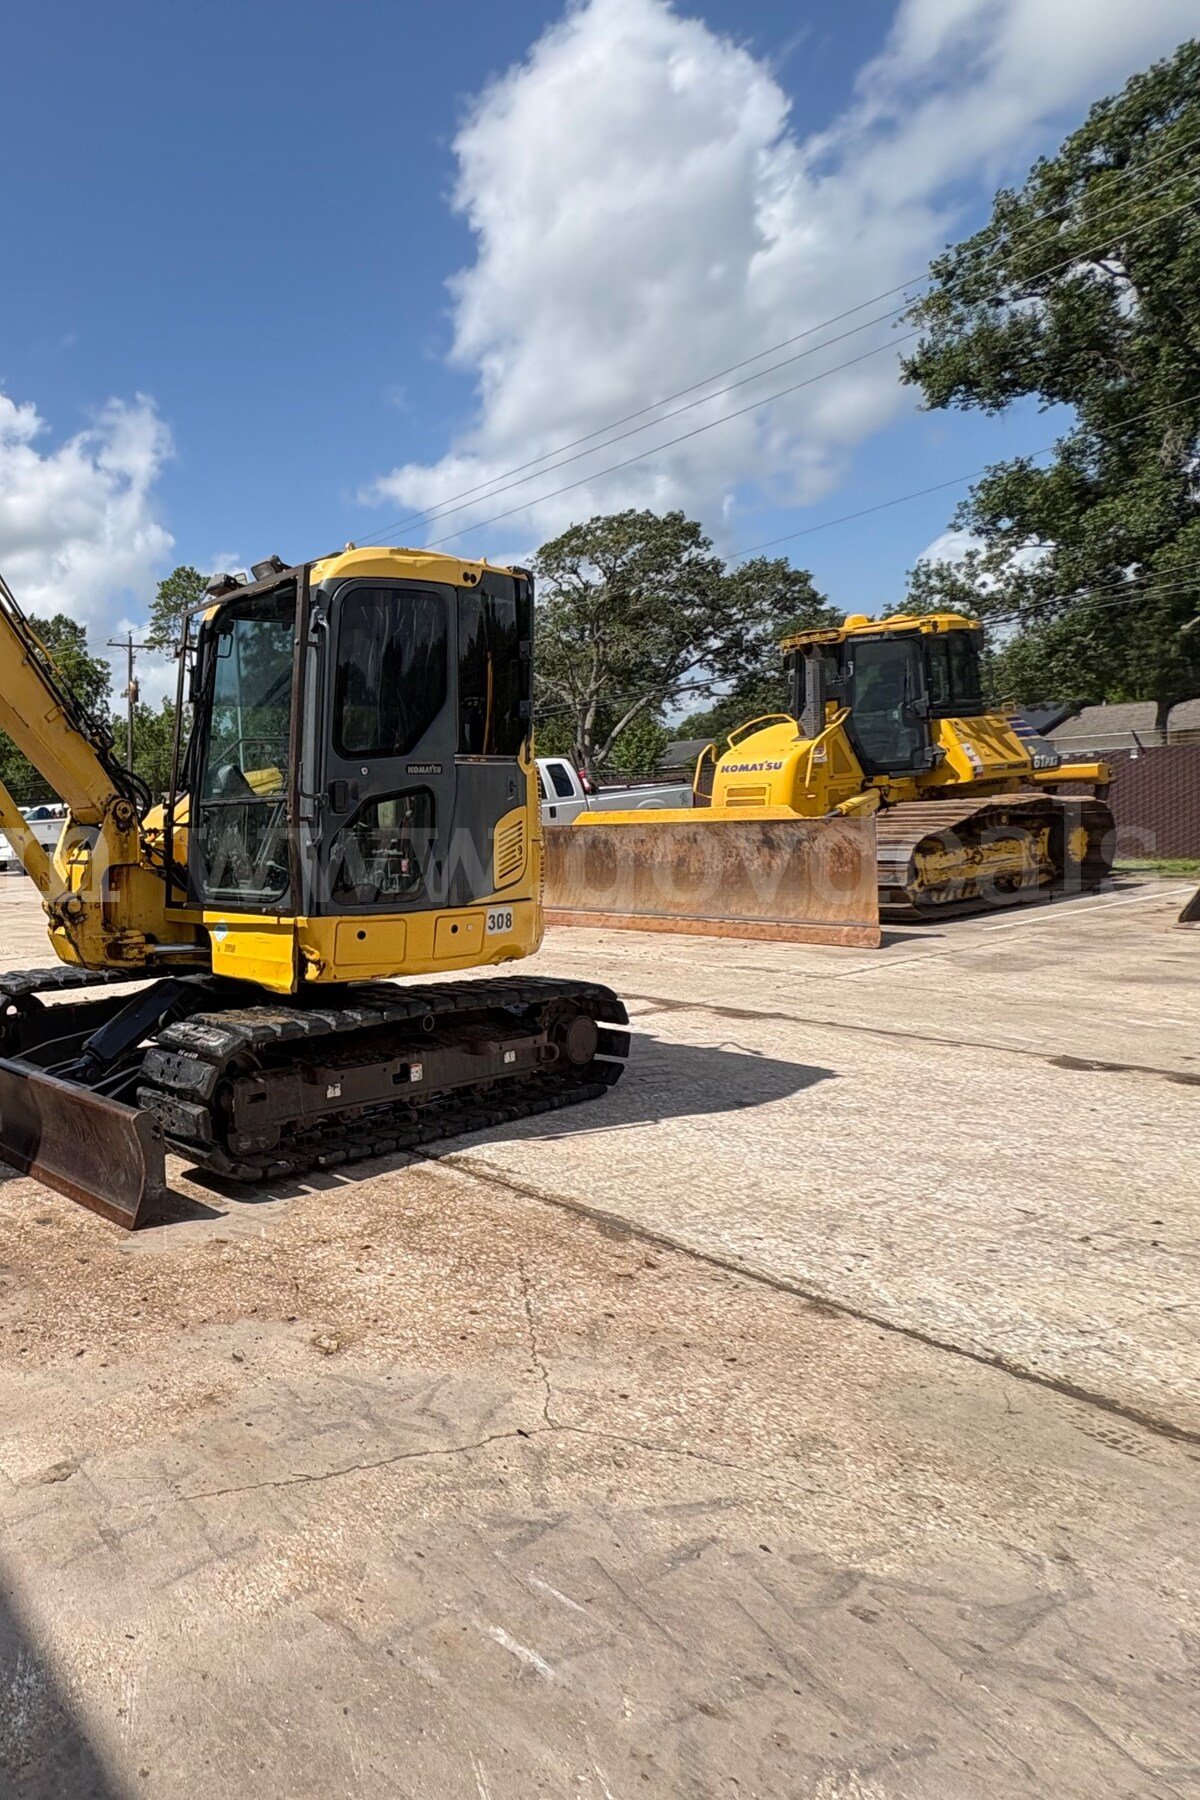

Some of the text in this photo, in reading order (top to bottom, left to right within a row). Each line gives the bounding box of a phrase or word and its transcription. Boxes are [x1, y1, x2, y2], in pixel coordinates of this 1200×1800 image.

[407, 764, 442, 774] KOMATSU
[721, 761, 783, 773] KOMATSU
[487, 912, 512, 931] 308
